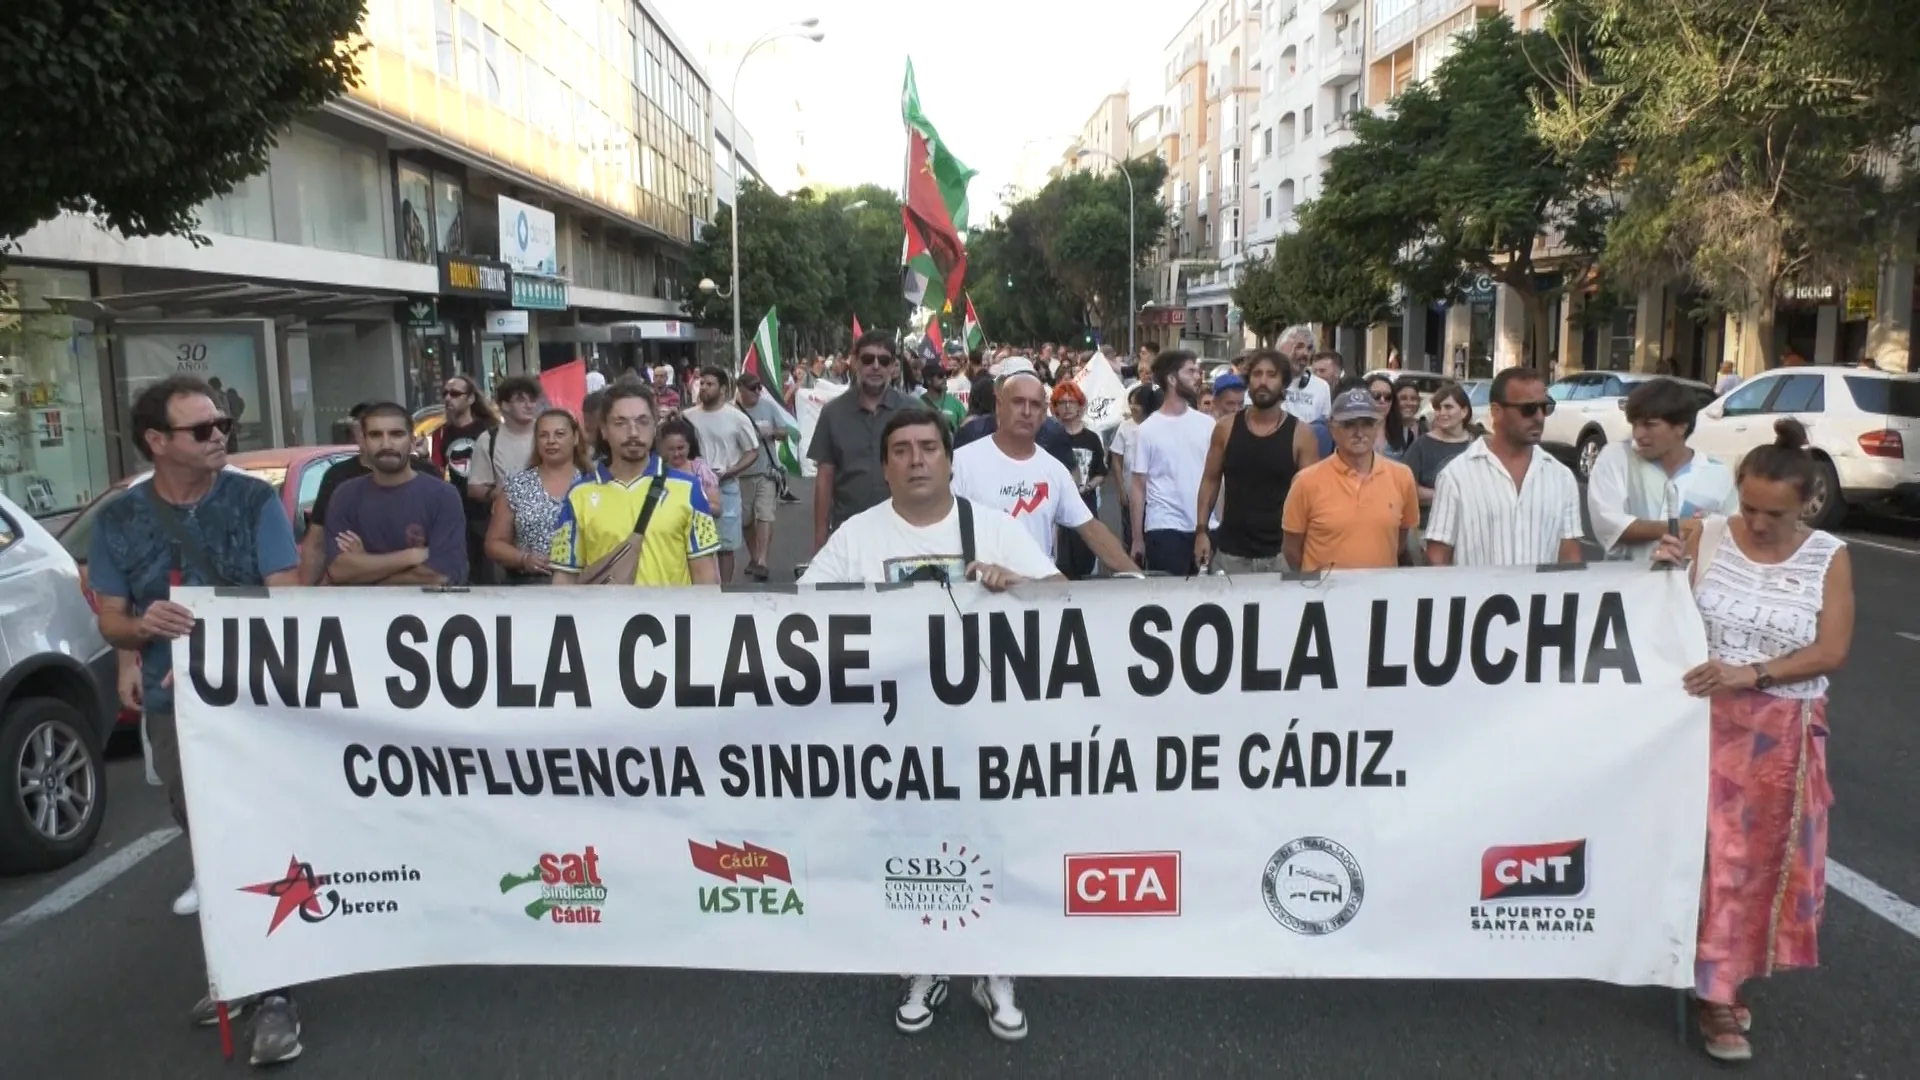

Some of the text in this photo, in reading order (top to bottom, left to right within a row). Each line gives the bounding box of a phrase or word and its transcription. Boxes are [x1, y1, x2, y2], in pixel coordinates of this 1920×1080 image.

[177, 344, 207, 361] 30
[186, 591, 1641, 726] UNA SOLA CLASE, UNA SOLA LUCHA
[344, 718, 1406, 800] CONFLUENCIA SINDICAL BAHÍA DE CÁDIZ.
[540, 846, 602, 885] sat
[719, 852, 768, 869] Cádiz
[1495, 856, 1572, 885] CNT
[543, 885, 606, 900] Sindicato
[1077, 867, 1167, 903] CTA
[699, 886, 804, 915] USTEA
[552, 905, 601, 923] Cádiz
[1470, 906, 1596, 919] EL PUERTO DE
[1472, 919, 1530, 931] SANTA
